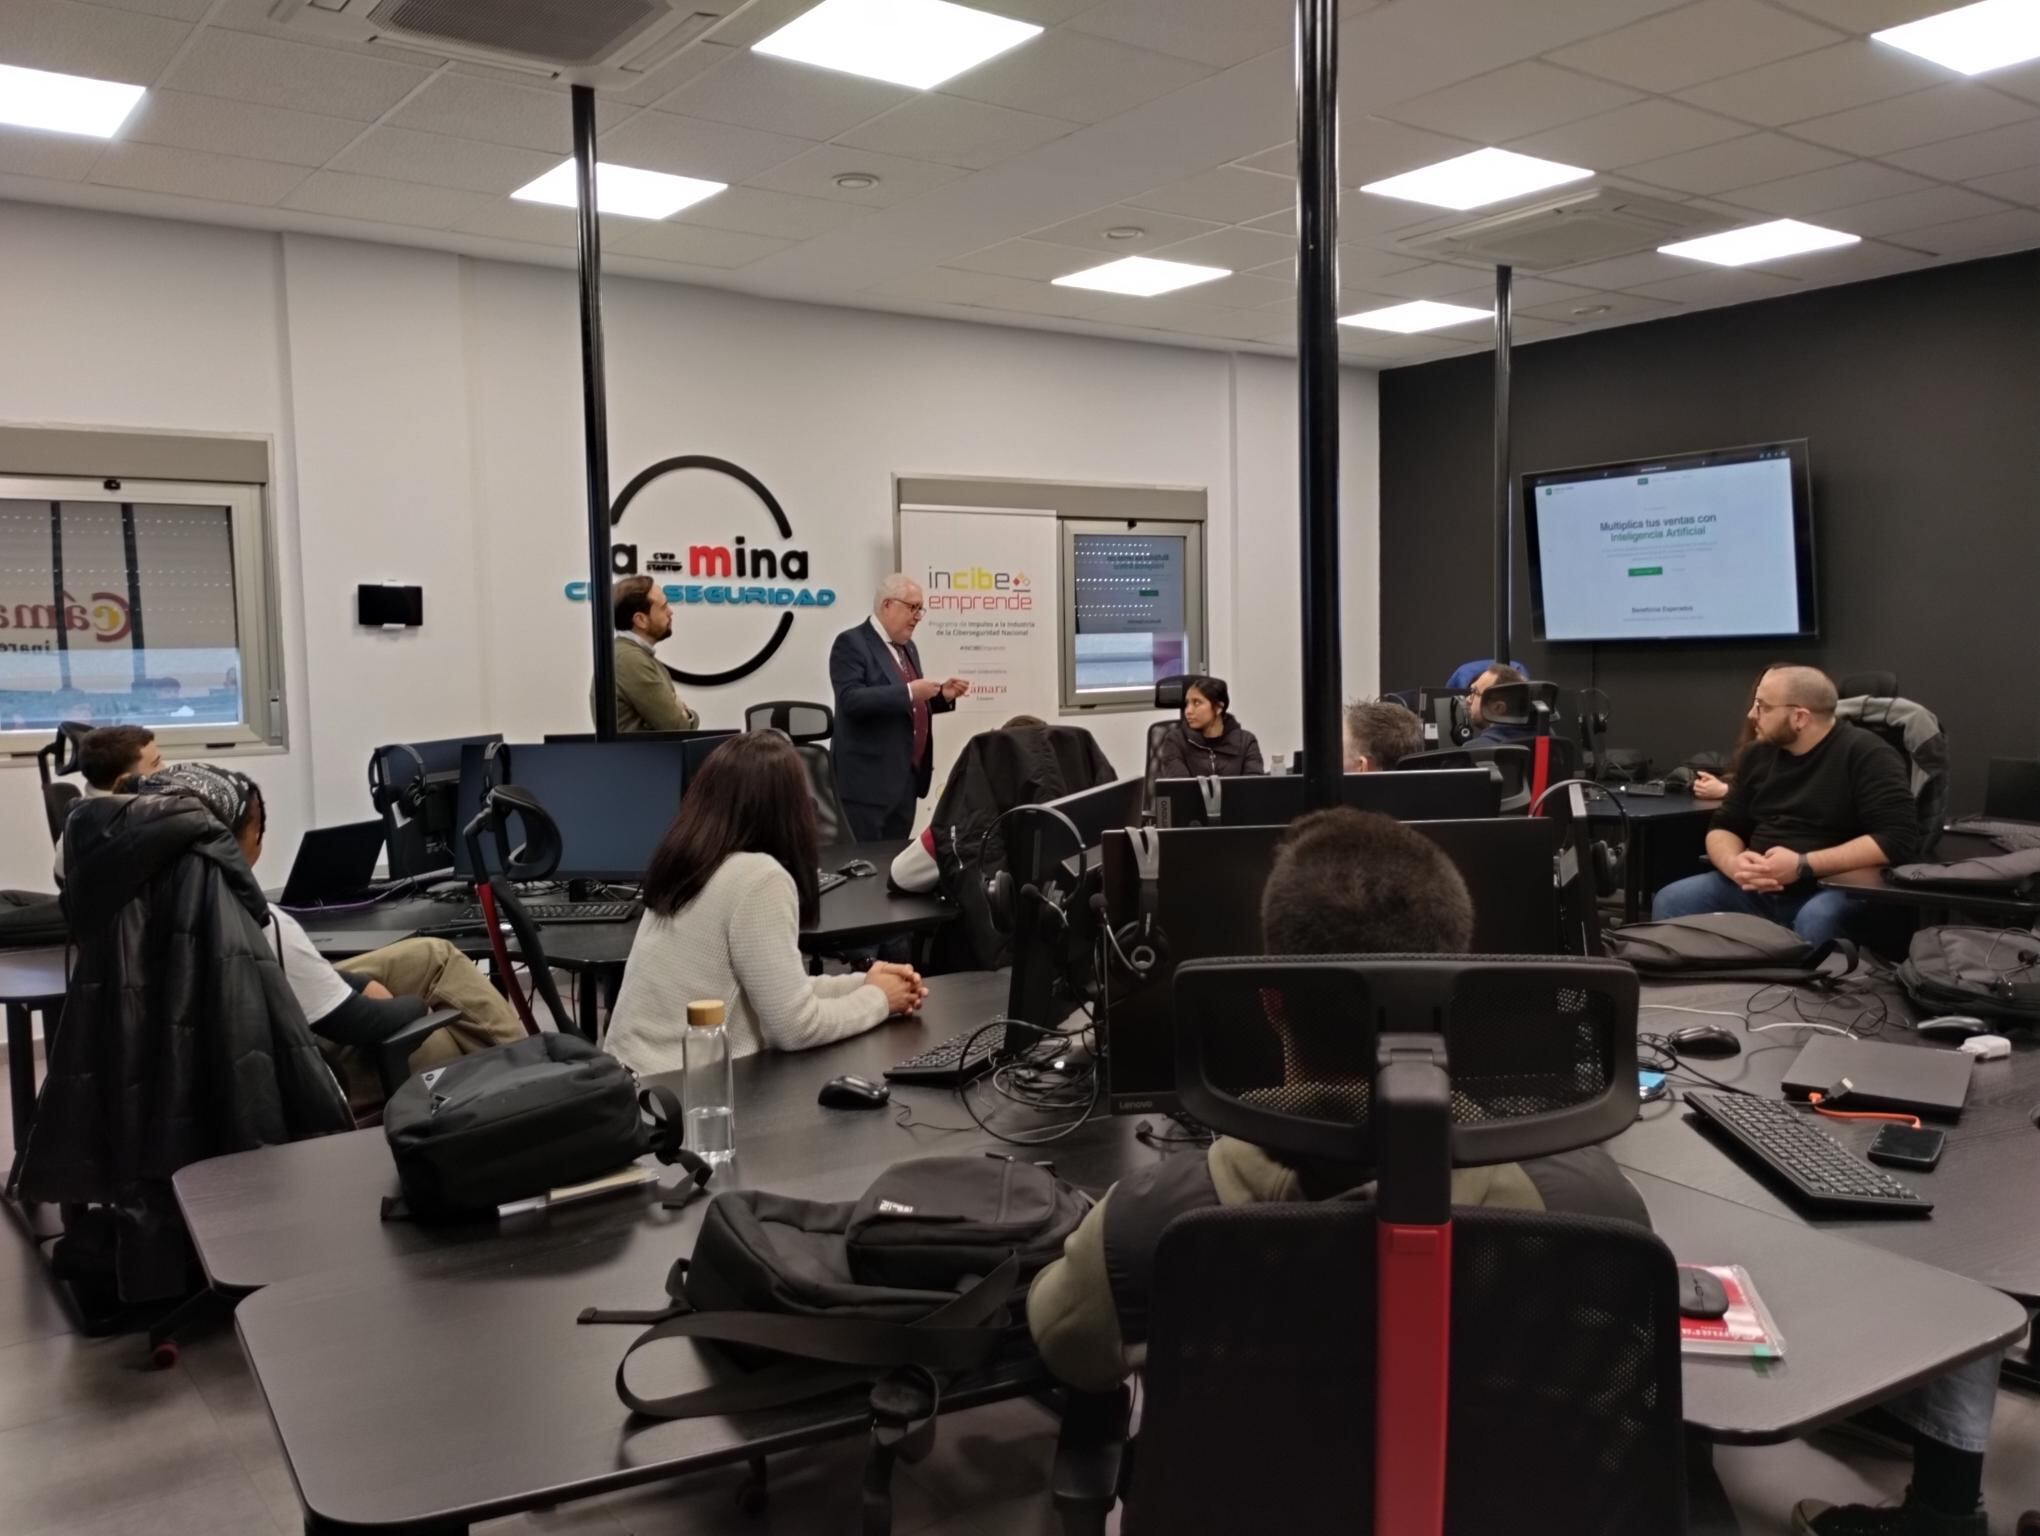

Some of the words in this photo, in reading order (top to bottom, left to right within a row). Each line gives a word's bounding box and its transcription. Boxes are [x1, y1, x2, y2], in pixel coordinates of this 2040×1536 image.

[1600, 520, 1644, 532] Multiplica
[1645, 519, 1661, 528] tus
[1663, 516, 1695, 526] ventas
[1697, 514, 1717, 523] con
[1611, 531, 1663, 543] Inteligencia
[1666, 526, 1706, 537] Artificial
[689, 536, 808, 580] mina
[928, 565, 1010, 590] incibe
[564, 581, 837, 607] CISEGURIDAD
[928, 593, 1032, 614] emprende
